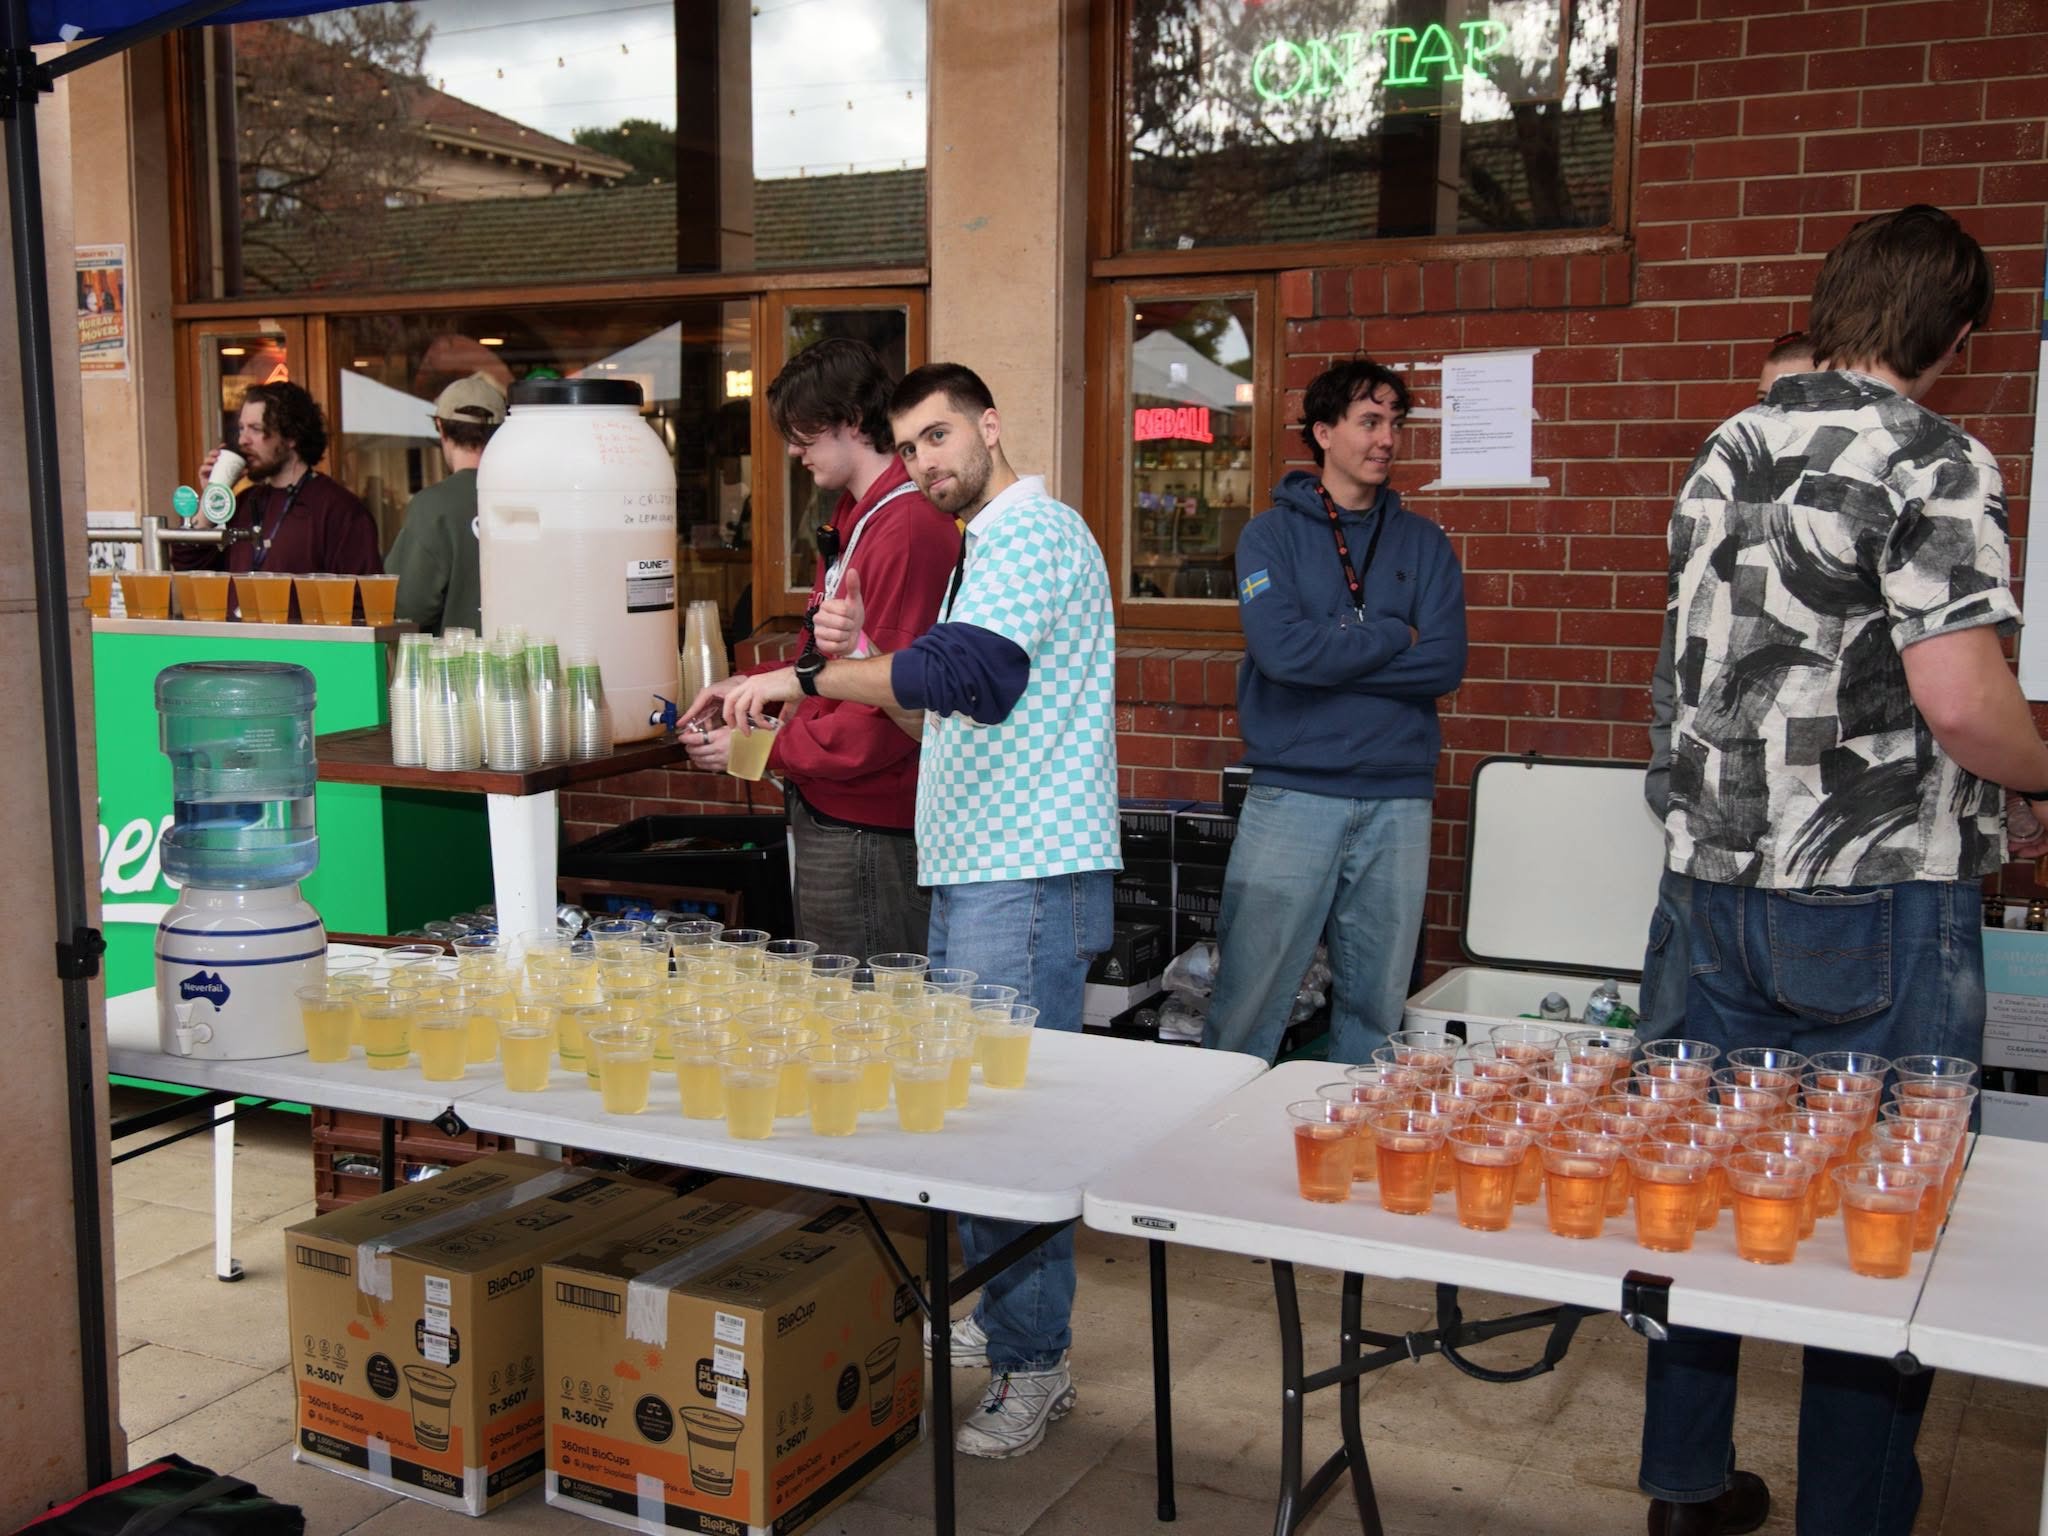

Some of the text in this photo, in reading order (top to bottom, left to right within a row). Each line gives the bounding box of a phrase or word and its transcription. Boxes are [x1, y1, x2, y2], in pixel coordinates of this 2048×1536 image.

[1253, 20, 1508, 100] ON TAP
[639, 561, 663, 569] DUNE
[184, 982, 224, 993] Neverfail
[305, 1364, 344, 1385] R-360Y
[308, 1395, 364, 1421] 360ml BioCups
[489, 1387, 529, 1416] R-360Y
[561, 1407, 608, 1429] R-360Y
[561, 1439, 590, 1456] 360ml
[592, 1447, 631, 1466] BioCups
[776, 1426, 809, 1458] R-360Y
[422, 1470, 456, 1490] BioPak
[699, 1515, 740, 1536] BioPak
